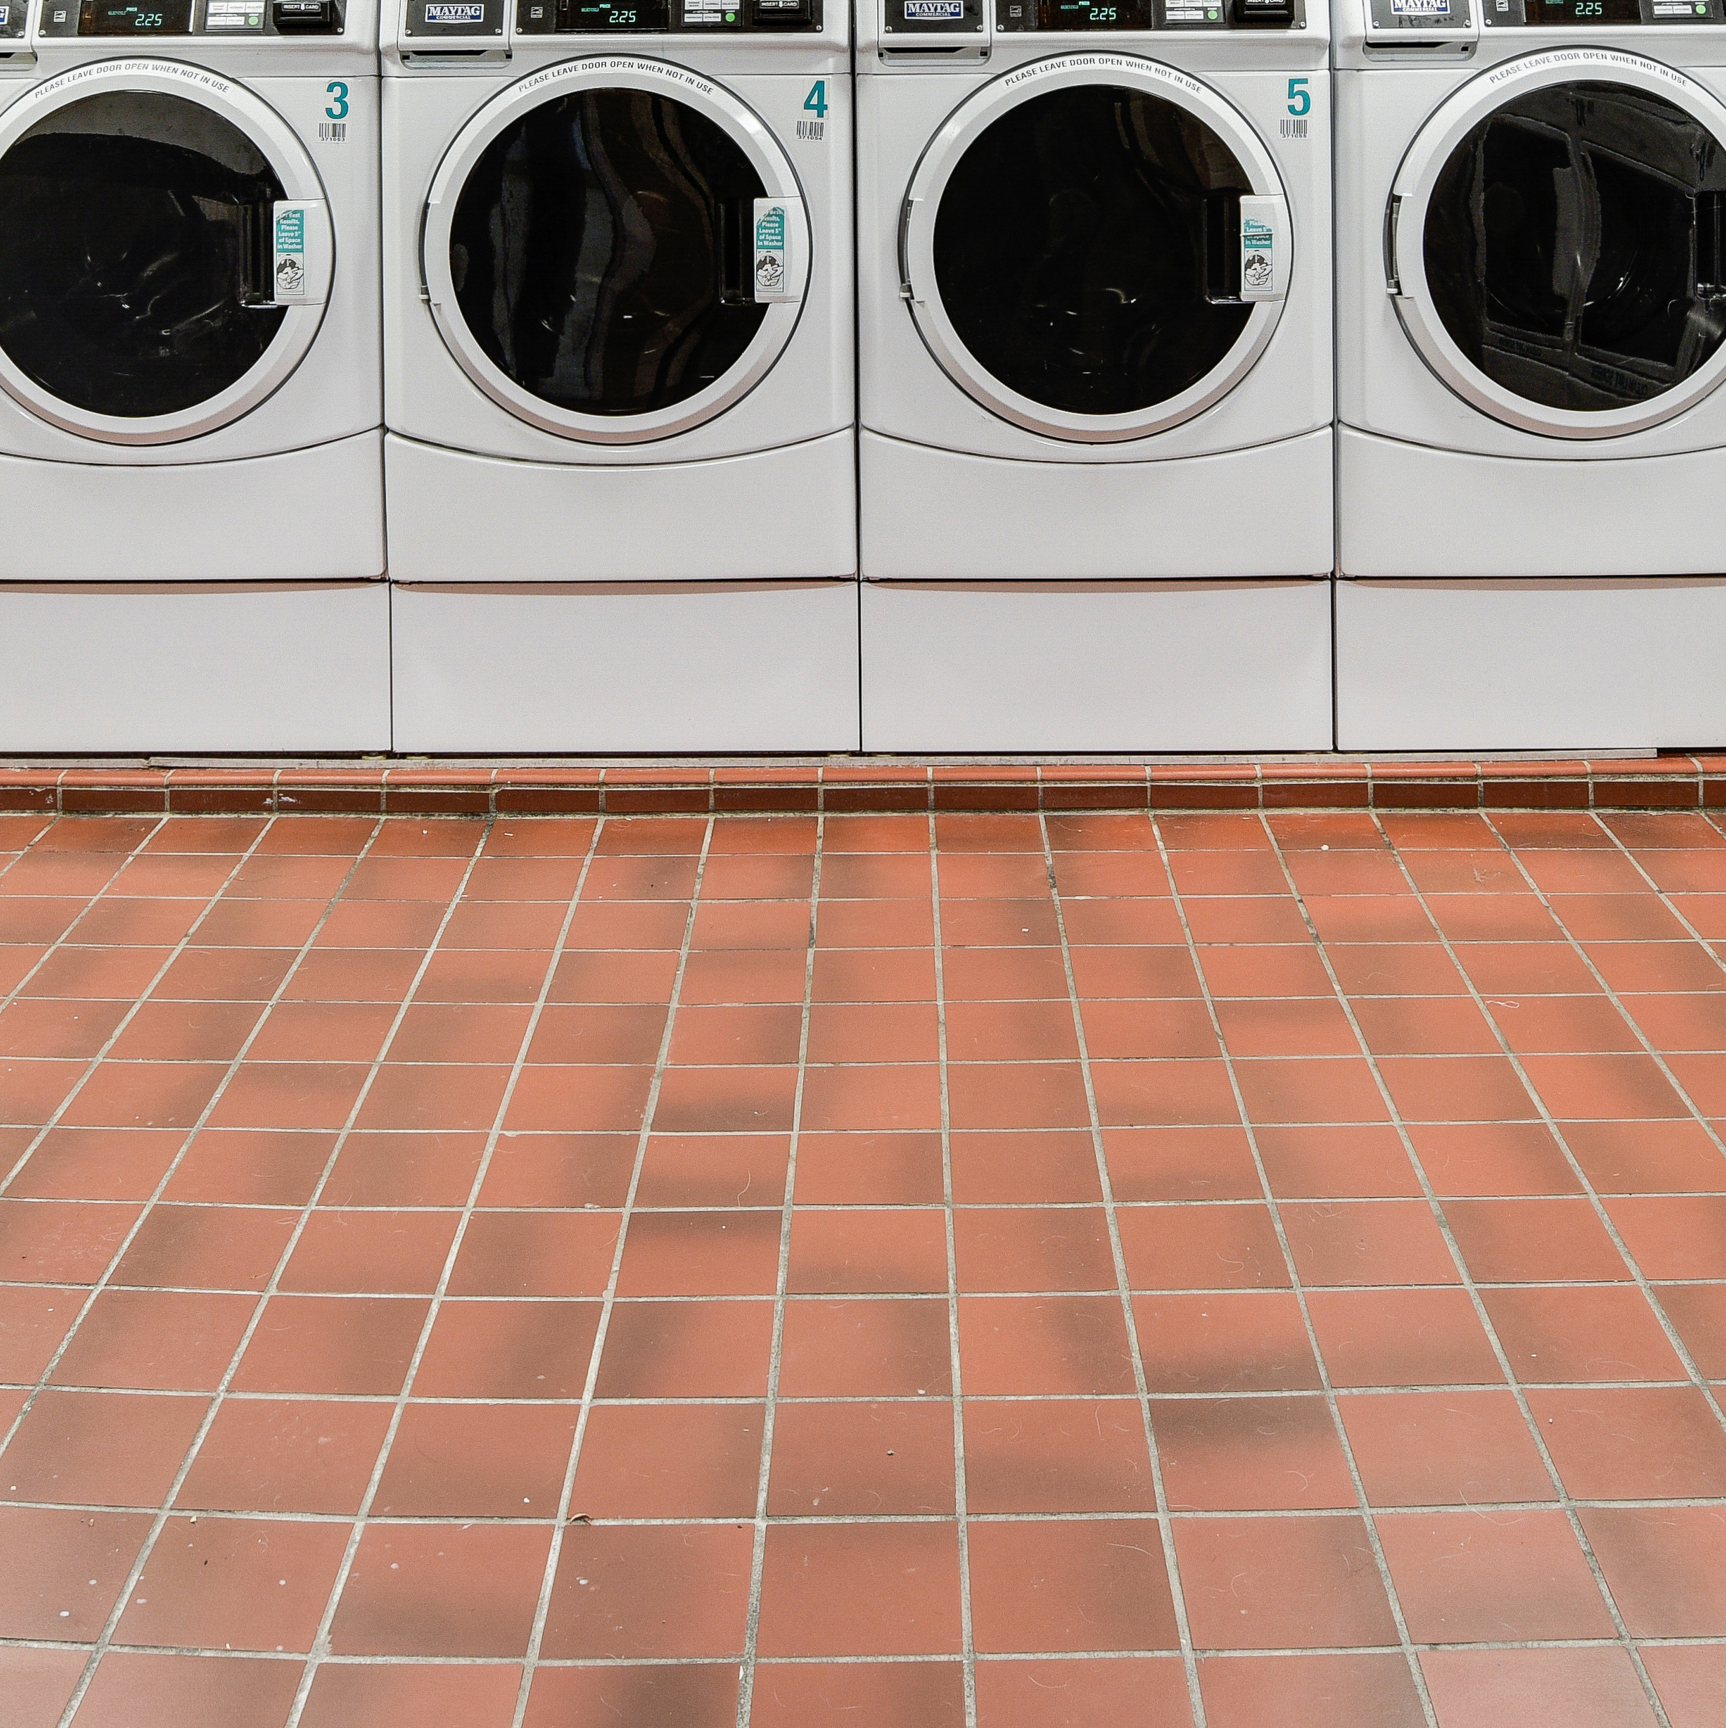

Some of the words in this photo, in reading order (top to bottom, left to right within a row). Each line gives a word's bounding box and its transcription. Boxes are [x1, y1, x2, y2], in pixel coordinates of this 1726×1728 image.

[428, 6, 481, 17] MAYTAG
[908, 3, 960, 14] MAYTAG
[1089, 8, 1117, 21] 2.25
[1575, 2, 1602, 16] 2.25
[135, 13, 162, 27] 2.25
[609, 10, 636, 24] 2.25
[518, 74, 550, 92] PLEASE
[552, 65, 579, 78] LEAVE
[582, 61, 607, 70] DOOR
[637, 62, 664, 74] WHEN
[665, 69, 683, 81] NOT
[685, 77, 695, 85] IN
[695, 81, 714, 95] USE
[325, 81, 349, 120] 3
[803, 80, 828, 118] 4
[1287, 78, 1310, 116] 5
